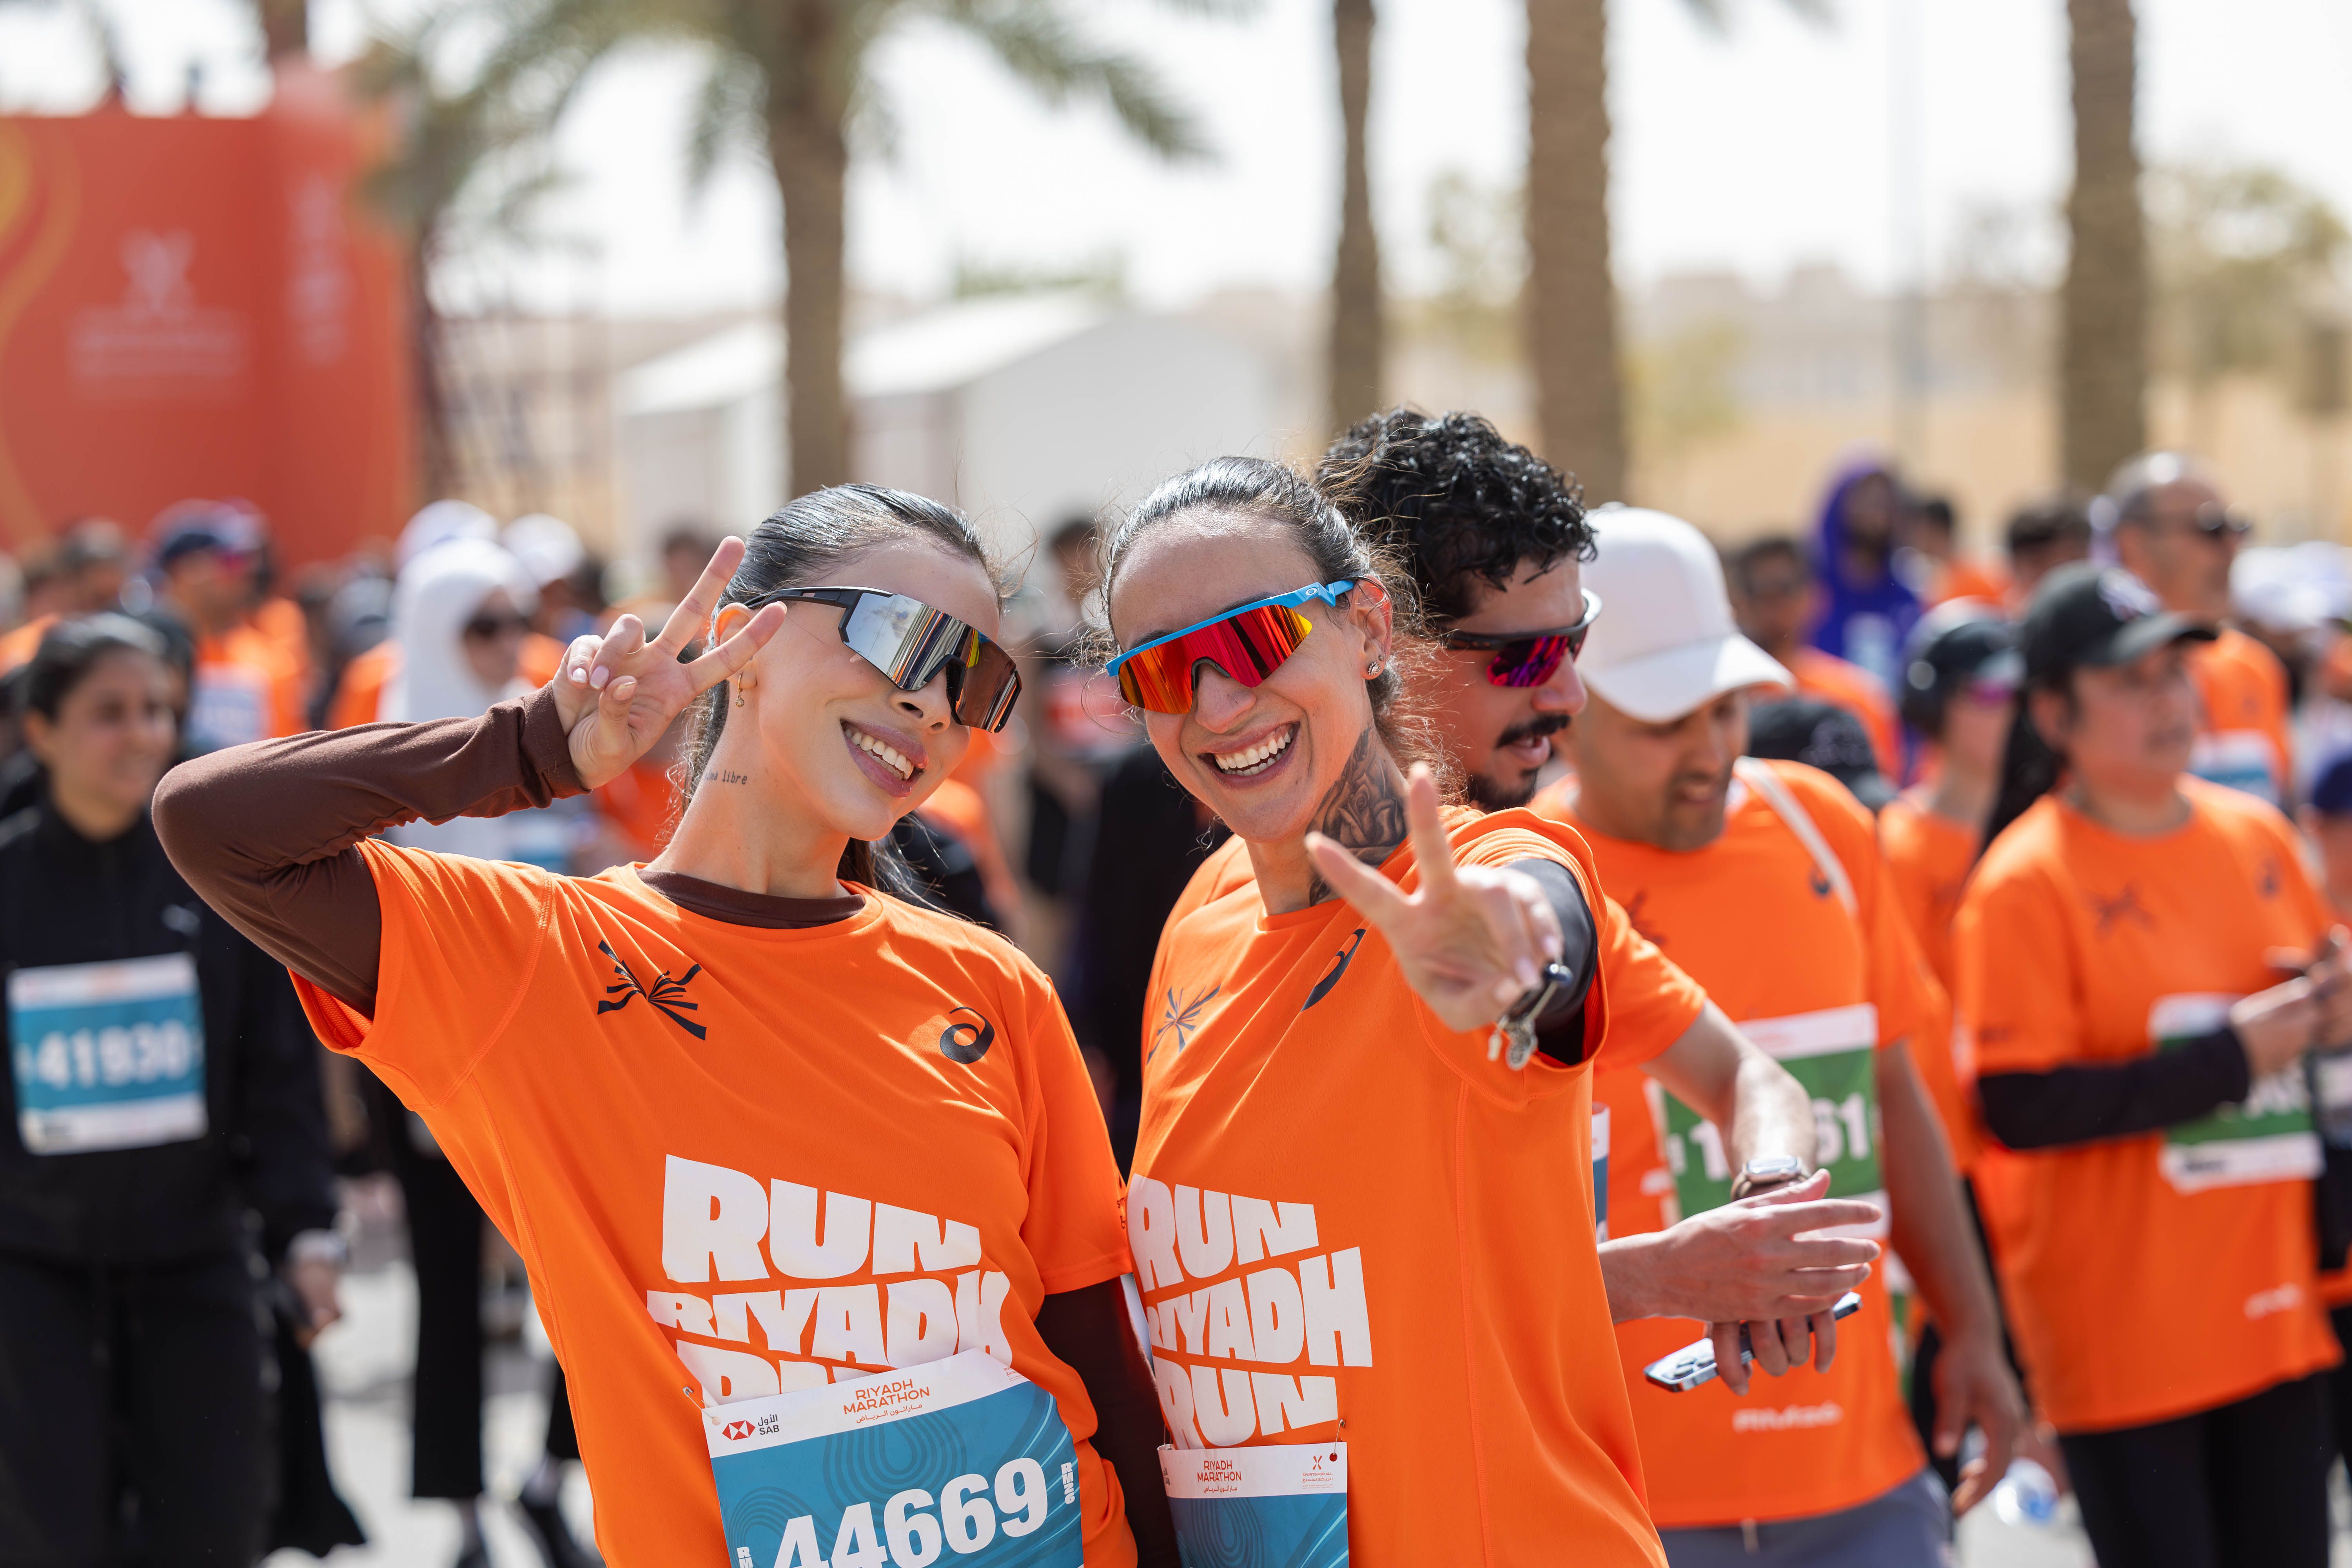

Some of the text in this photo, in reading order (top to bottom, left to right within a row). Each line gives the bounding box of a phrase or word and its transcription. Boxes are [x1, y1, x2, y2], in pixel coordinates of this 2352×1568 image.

[722, 770, 747, 784] libre
[662, 1154, 981, 1282] RUN
[1126, 1173, 1319, 1292] RUN
[647, 1270, 1012, 1369] RIYADH
[843, 1387, 930, 1414] MARATHON
[855, 1379, 913, 1400] RIYADH
[856, 1404, 922, 1423] ماراثون الرياض
[1153, 1356, 1338, 1450] RUN
[758, 1414, 778, 1426] الأول
[759, 1425, 779, 1435] SAB
[1197, 1471, 1241, 1482] MARATHON
[1204, 1460, 1232, 1470] RIYADH
[1061, 1462, 1075, 1504] RM26
[773, 1457, 1047, 1568] 44669
